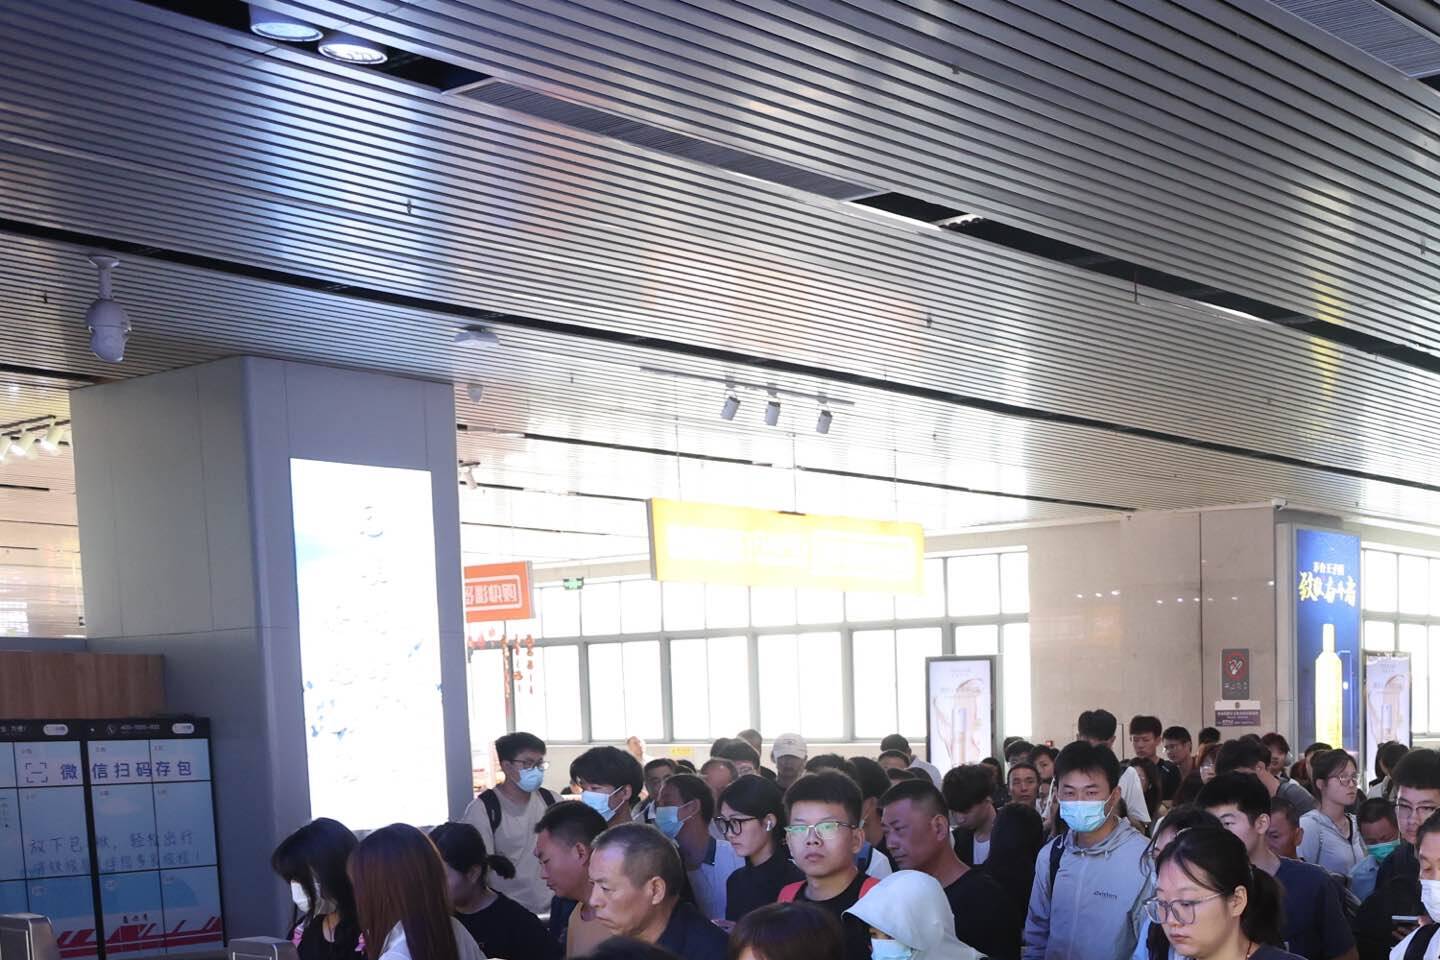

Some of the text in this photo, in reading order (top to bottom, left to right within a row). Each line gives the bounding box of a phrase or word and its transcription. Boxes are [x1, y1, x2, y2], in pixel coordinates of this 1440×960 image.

[60, 761, 192, 780] 微信扫码存包
